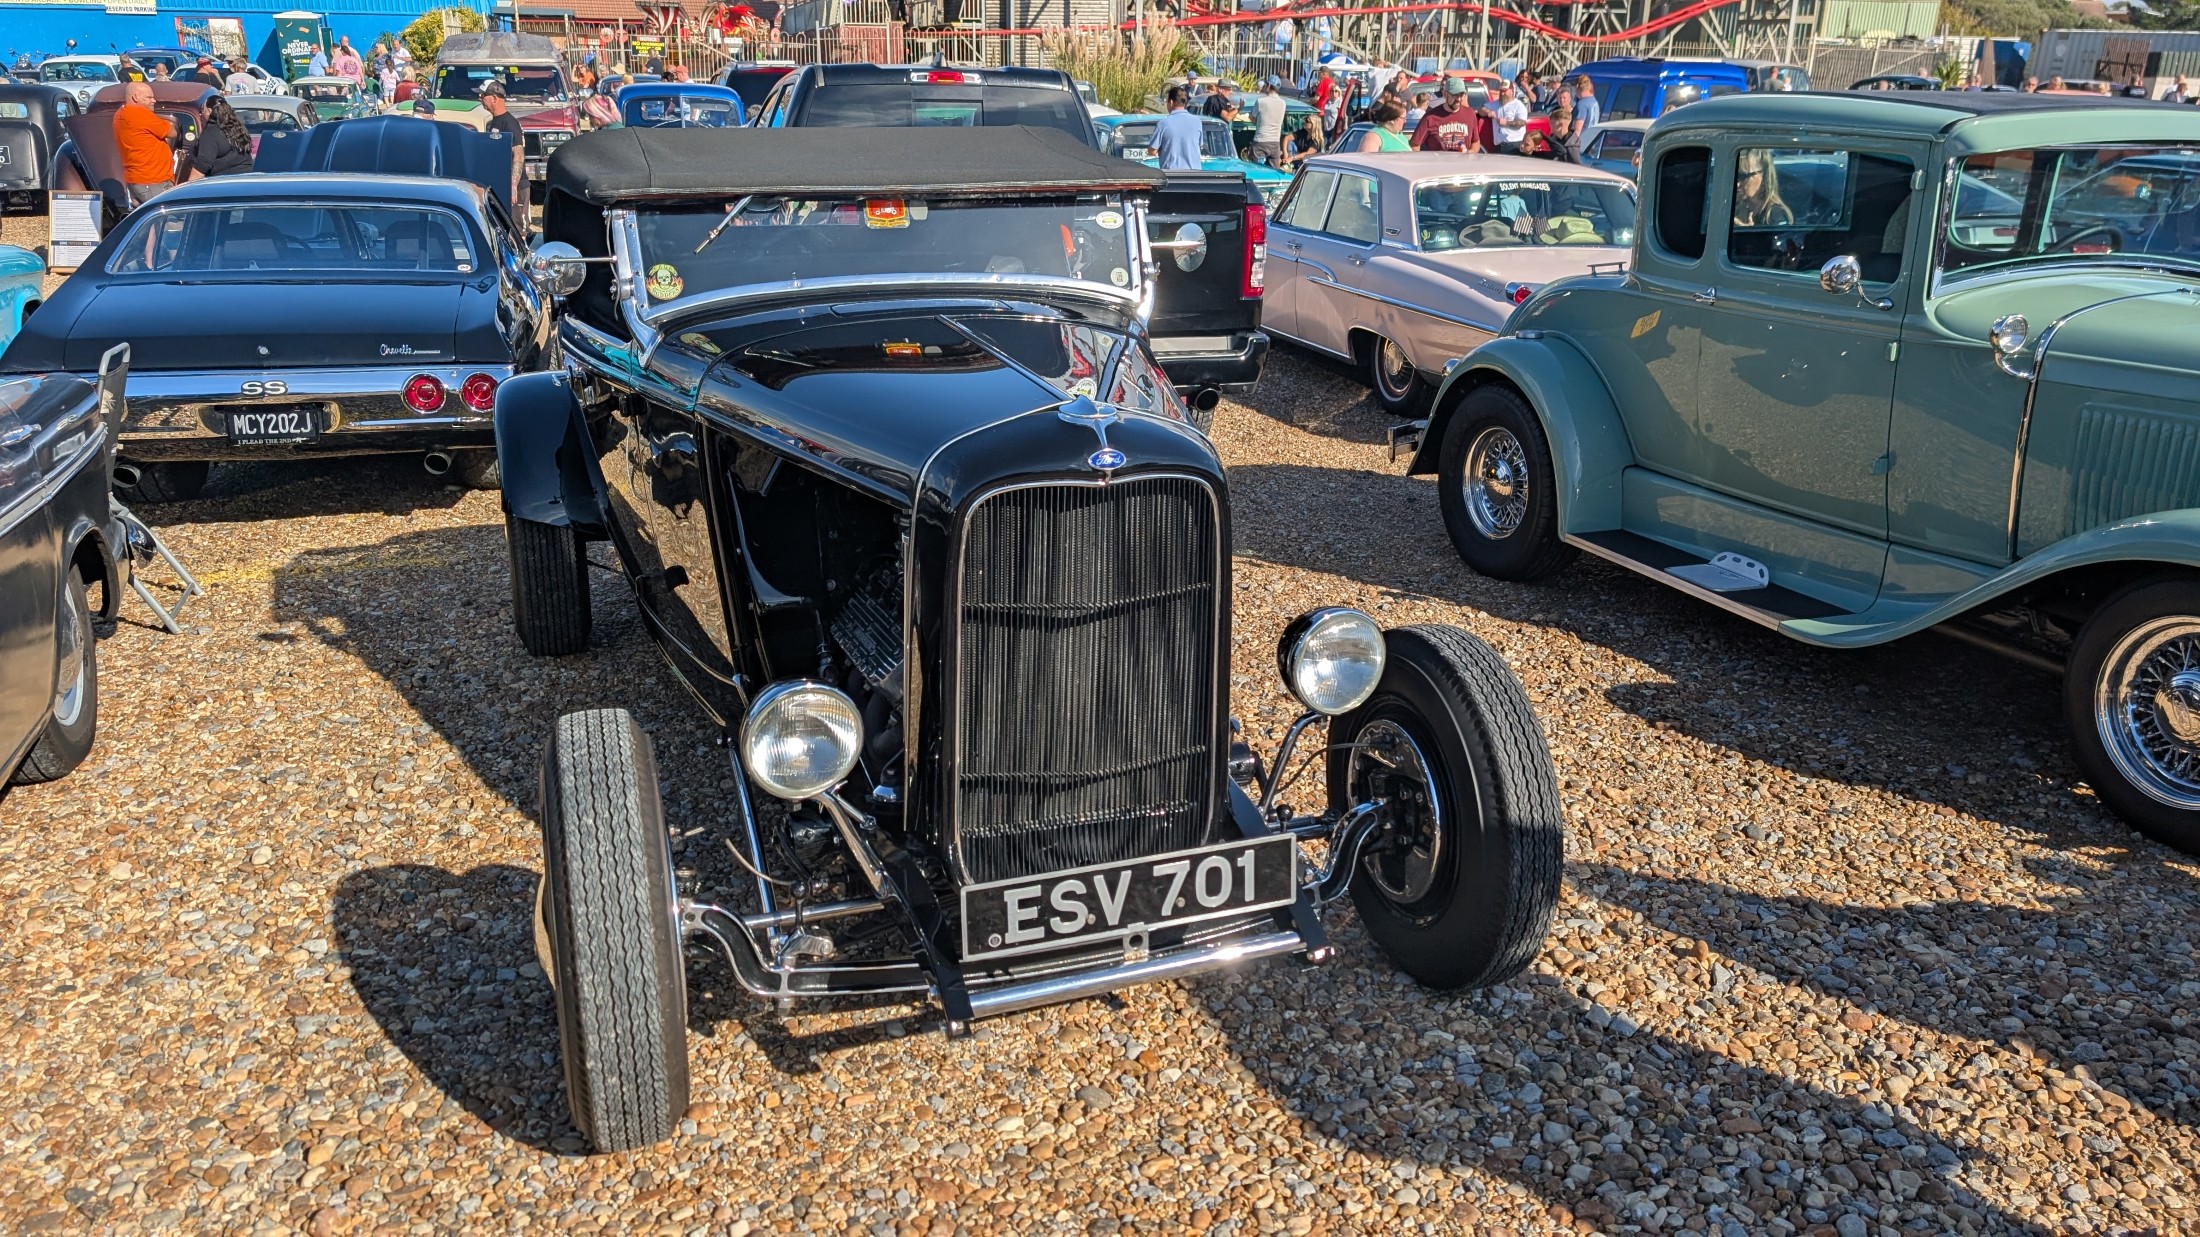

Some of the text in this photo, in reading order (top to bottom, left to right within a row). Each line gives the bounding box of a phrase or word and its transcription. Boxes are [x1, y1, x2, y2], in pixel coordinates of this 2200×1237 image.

[287, 41, 309, 49] NEVER
[1438, 121, 1469, 138] BROOKLYN
[1129, 150, 1144, 158] FOR
[1499, 182, 1551, 192] SOLENT RENEGADES
[241, 381, 288, 396] SS
[233, 412, 313, 435] MCY202J
[1095, 453, 1122, 466] Ford
[1004, 849, 1256, 945] ESV 701
